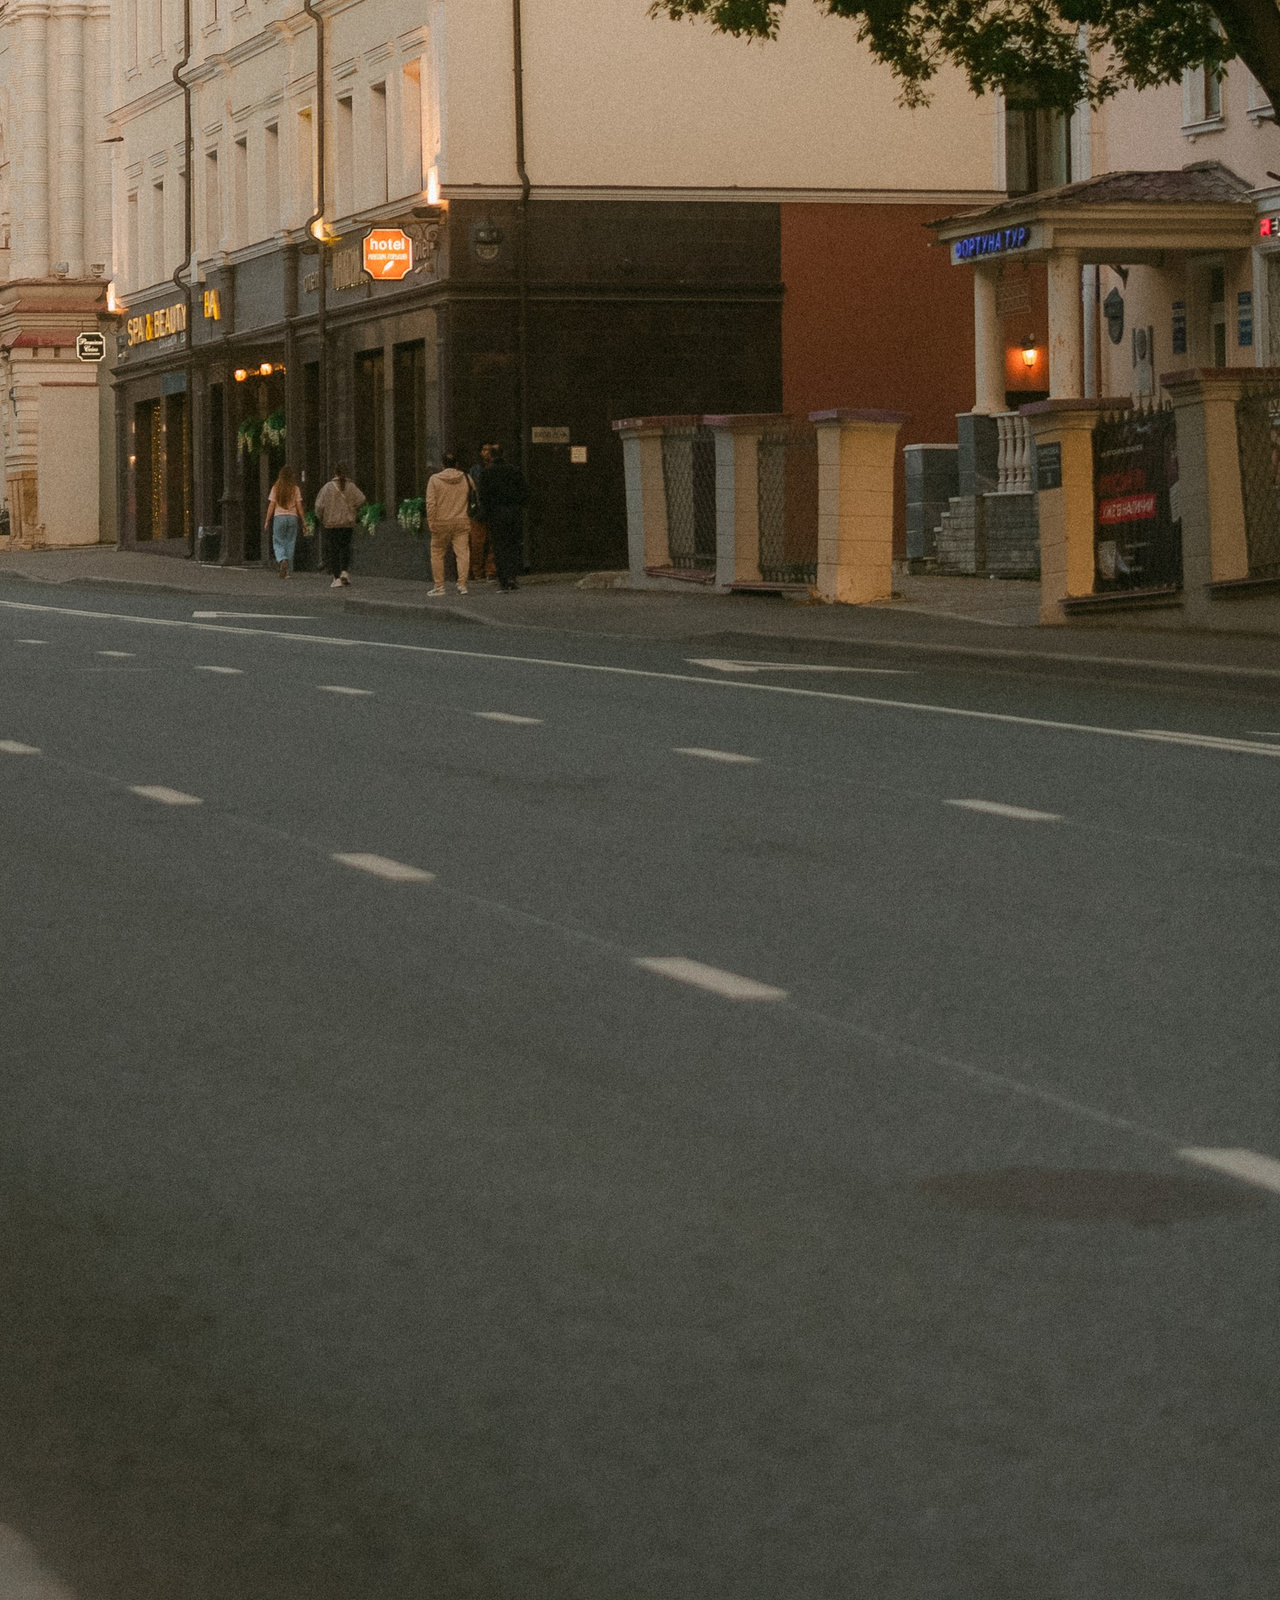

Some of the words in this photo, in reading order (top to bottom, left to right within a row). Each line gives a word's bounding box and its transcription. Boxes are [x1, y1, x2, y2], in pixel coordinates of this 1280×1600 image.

[369, 237, 405, 251] hotel
[955, 231, 1001, 259] ФОРТУНА
[1004, 226, 1026, 249] ТУР
[127, 317, 145, 346] SPA
[145, 313, 153, 341] &
[153, 303, 186, 339] BEAUTY
